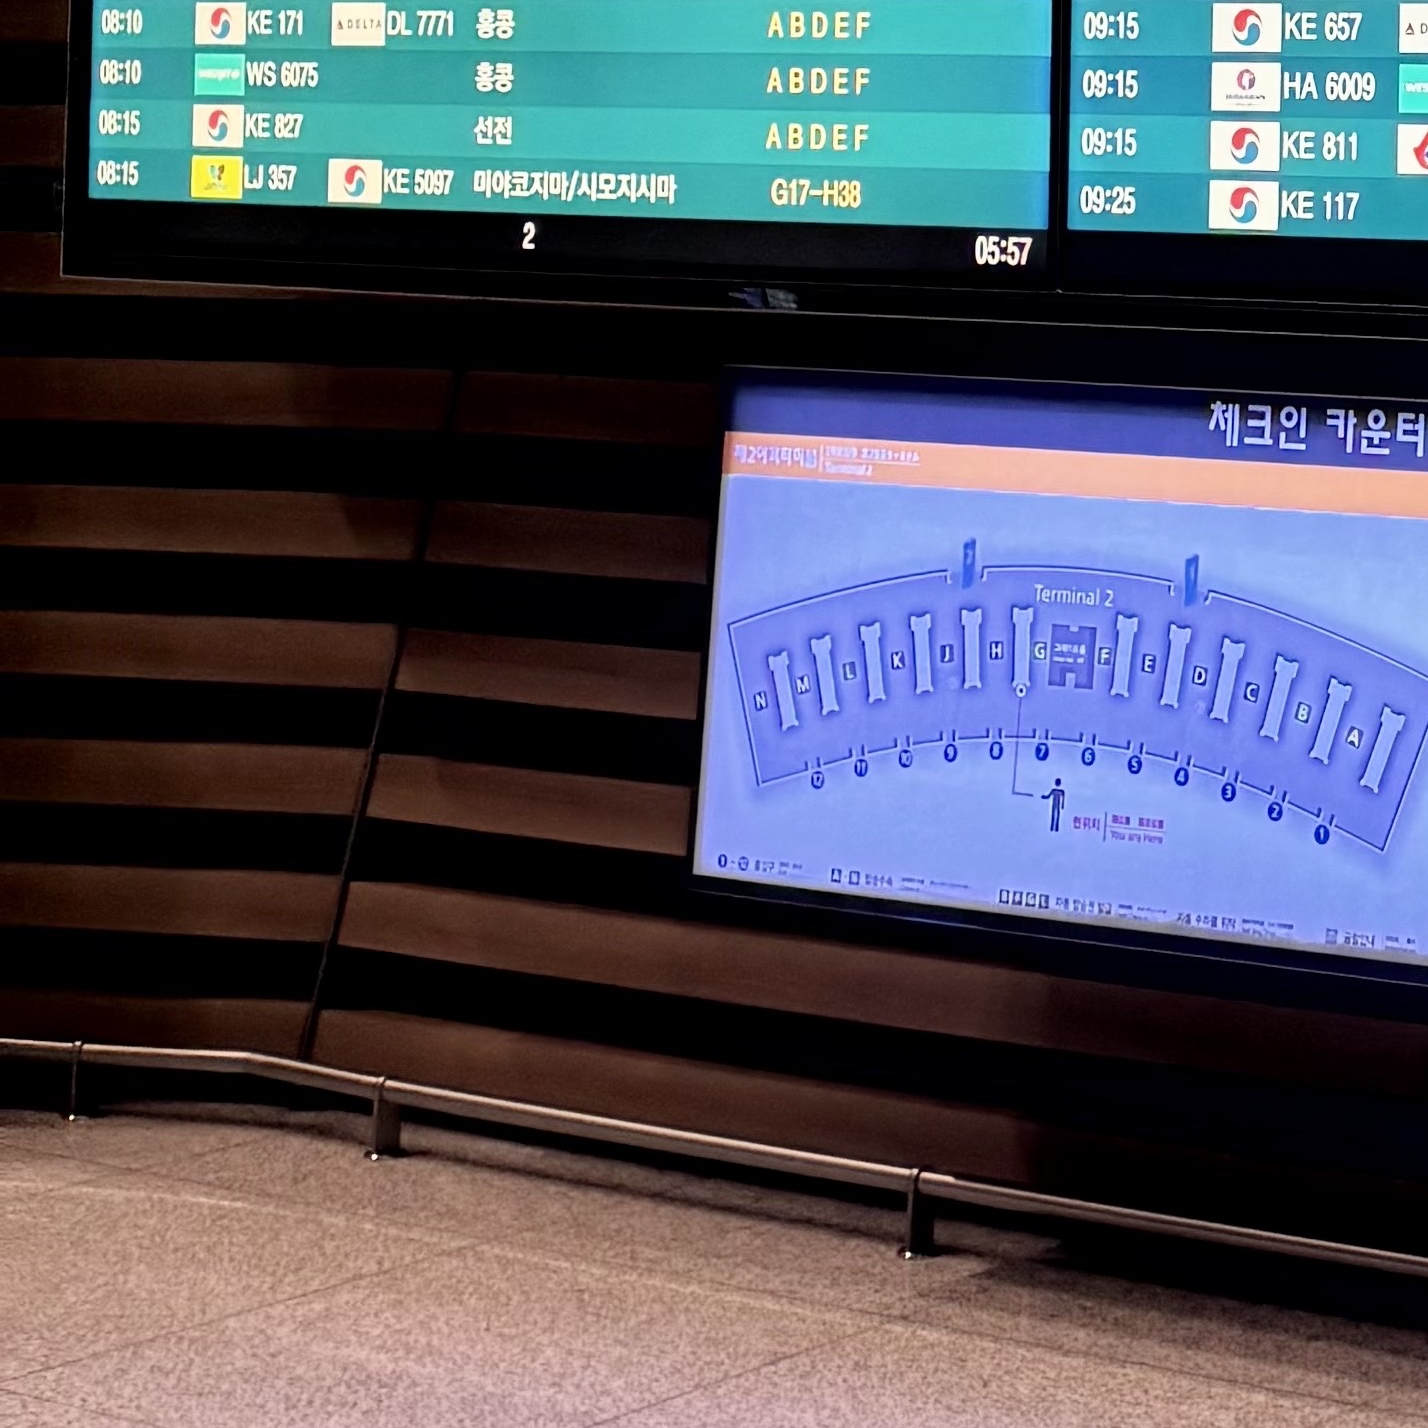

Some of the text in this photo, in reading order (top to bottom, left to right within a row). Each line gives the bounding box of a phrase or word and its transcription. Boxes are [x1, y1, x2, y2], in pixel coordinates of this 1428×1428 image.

[246, 61, 318, 87] WS 6075
[975, 235, 1033, 266] 05:57
[1209, 401, 1306, 450] 체크인
[1327, 409, 1424, 457] 카운터
[1034, 584, 1113, 607] Terminal 2
